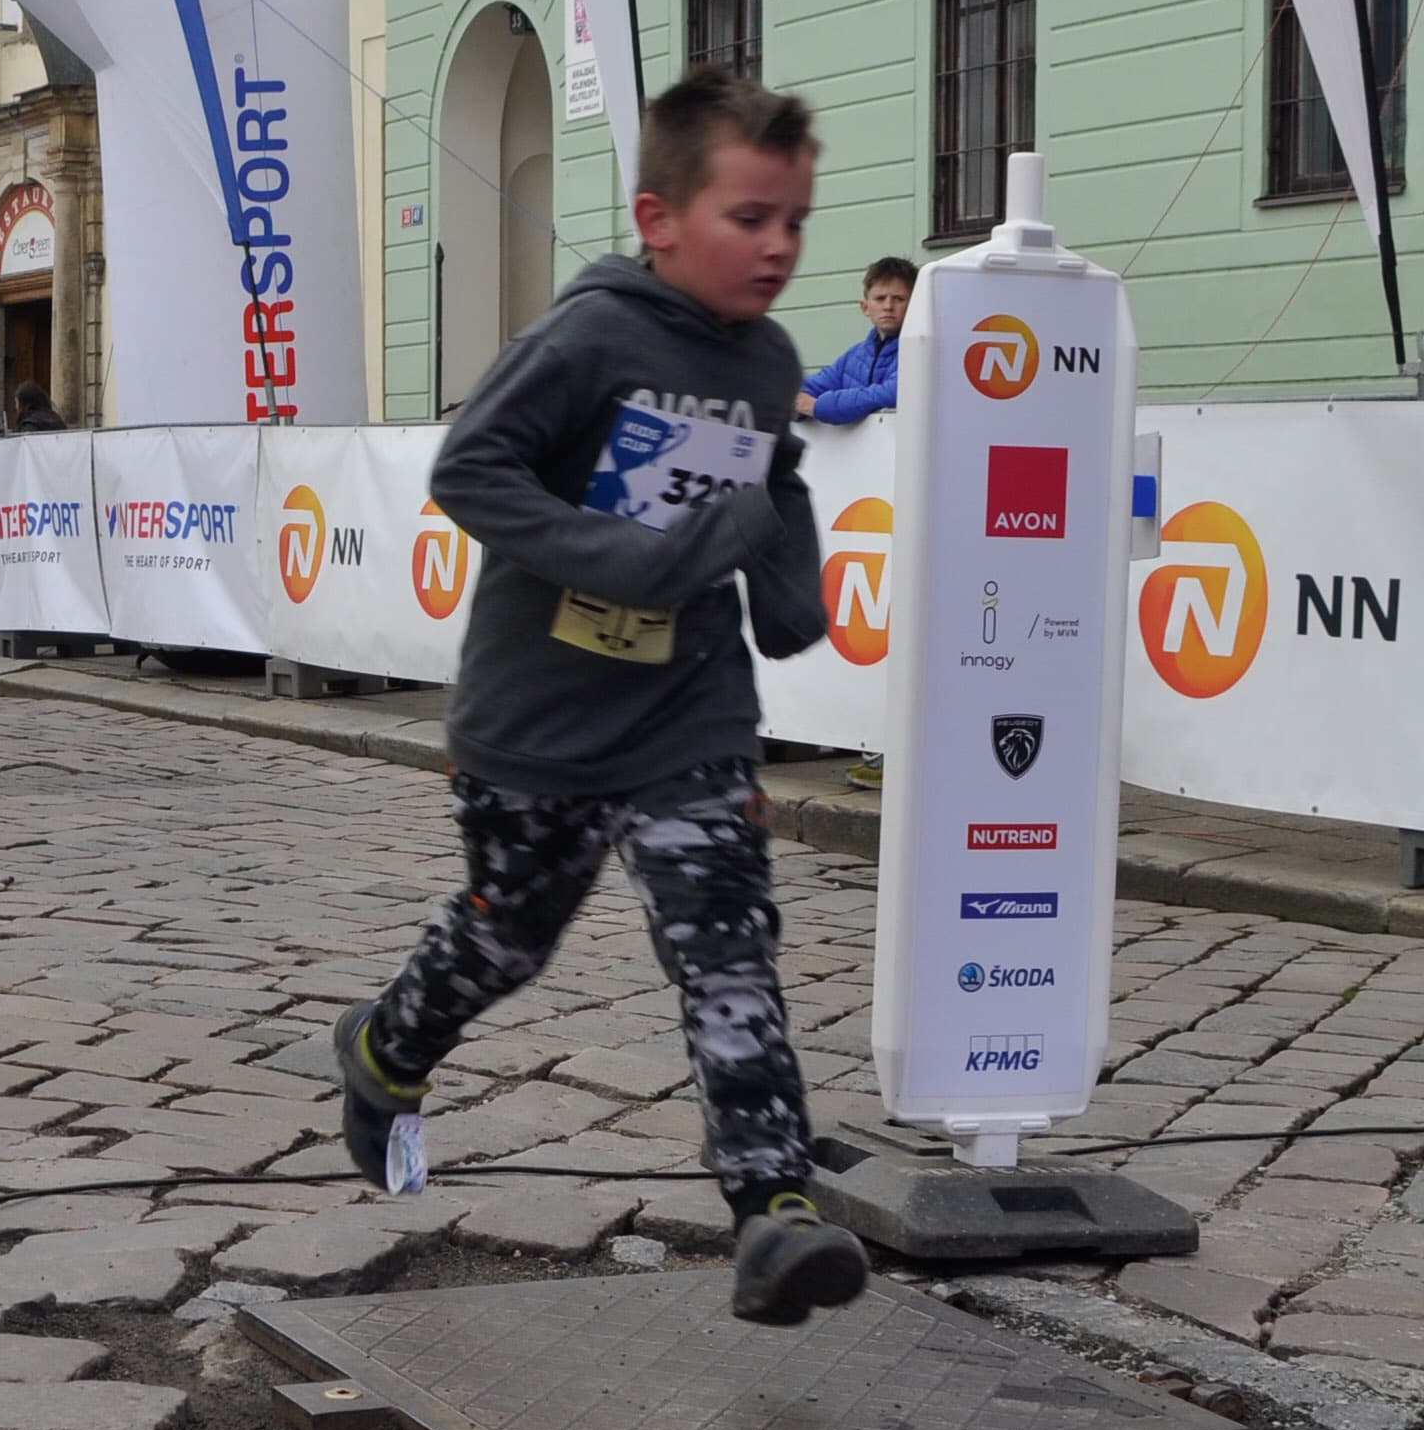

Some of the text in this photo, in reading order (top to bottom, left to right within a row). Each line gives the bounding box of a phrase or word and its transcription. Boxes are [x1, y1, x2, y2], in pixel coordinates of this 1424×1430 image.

[235, 67, 298, 421] TERSPORT
[1053, 346, 1101, 374] NN
[117, 501, 236, 544] NTERSPORT
[994, 512, 1057, 531] AVON
[331, 527, 364, 566] NN
[173, 556, 211, 571] SPORT
[1296, 573, 1401, 642] NN
[960, 651, 1015, 671] innogy
[973, 829, 1054, 846] NUTREND
[988, 965, 1055, 988] ŠKODA
[965, 1048, 1041, 1072] KPMG
